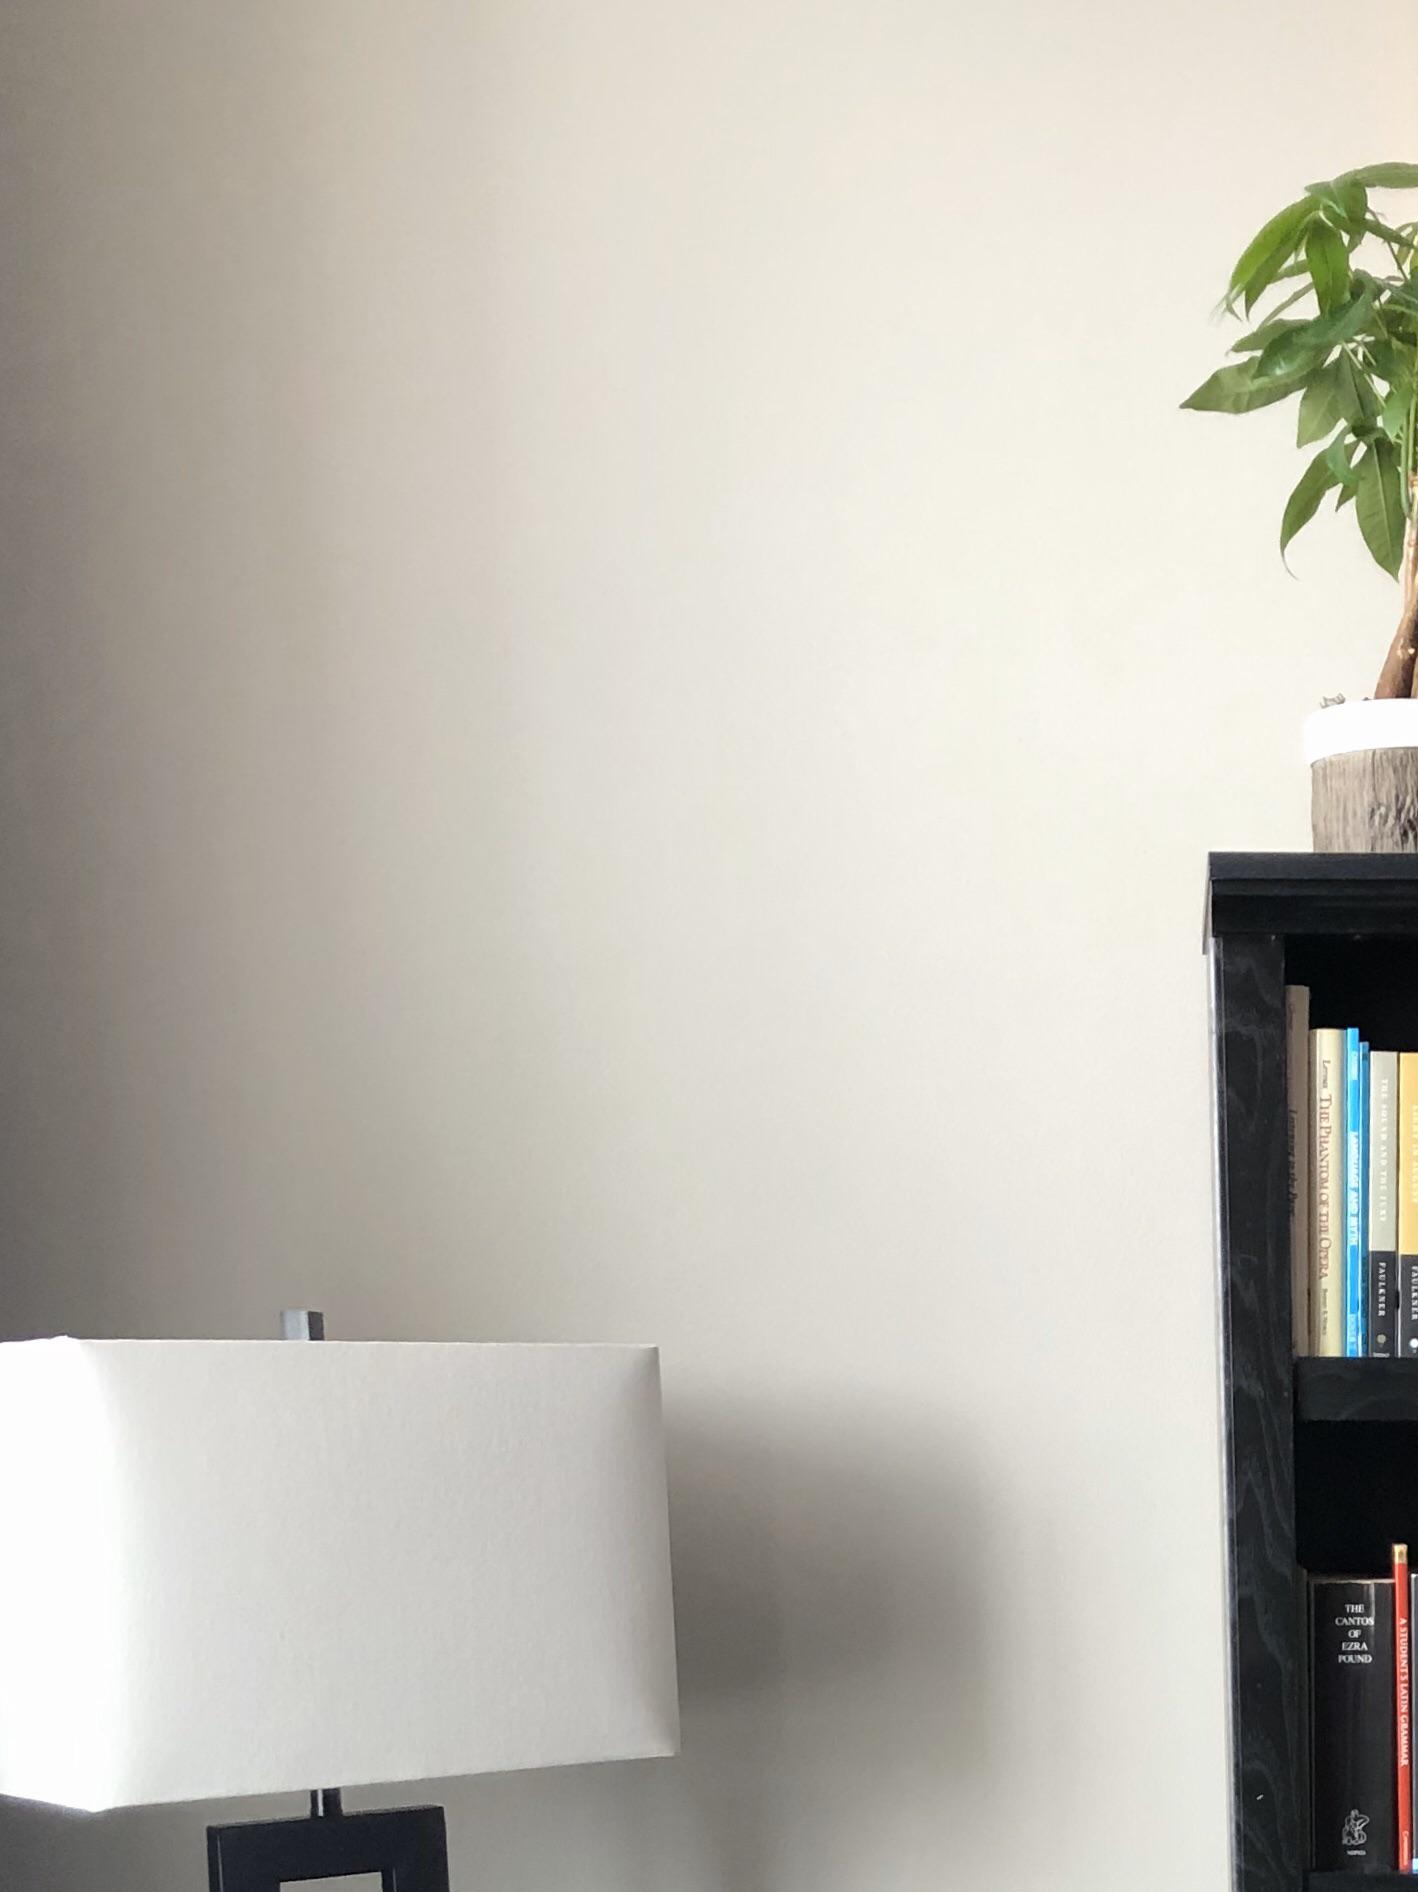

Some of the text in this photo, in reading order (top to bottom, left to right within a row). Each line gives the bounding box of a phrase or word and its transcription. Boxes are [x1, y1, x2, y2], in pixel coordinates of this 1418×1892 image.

[1318, 1095, 1332, 1124] THE
[1318, 1125, 1332, 1189] PHANTOM
[1318, 1192, 1332, 1206] OF
[1318, 1210, 1332, 1235] THE
[1318, 1237, 1332, 1280] OPERA
[1377, 1262, 1386, 1316] FAULKNER
[1410, 1265, 1418, 1321] FAULKNER
[1335, 1617, 1374, 1626] CANTOS
[1345, 1604, 1364, 1613] THE
[1342, 1642, 1367, 1651] EZRA
[1348, 1629, 1361, 1638] OF
[1338, 1654, 1372, 1664] POUND
[1399, 1627, 1408, 1681] STUDENT'S
[1399, 1683, 1408, 1713] LATIN
[1399, 1715, 1408, 1767] GRAMMAR
